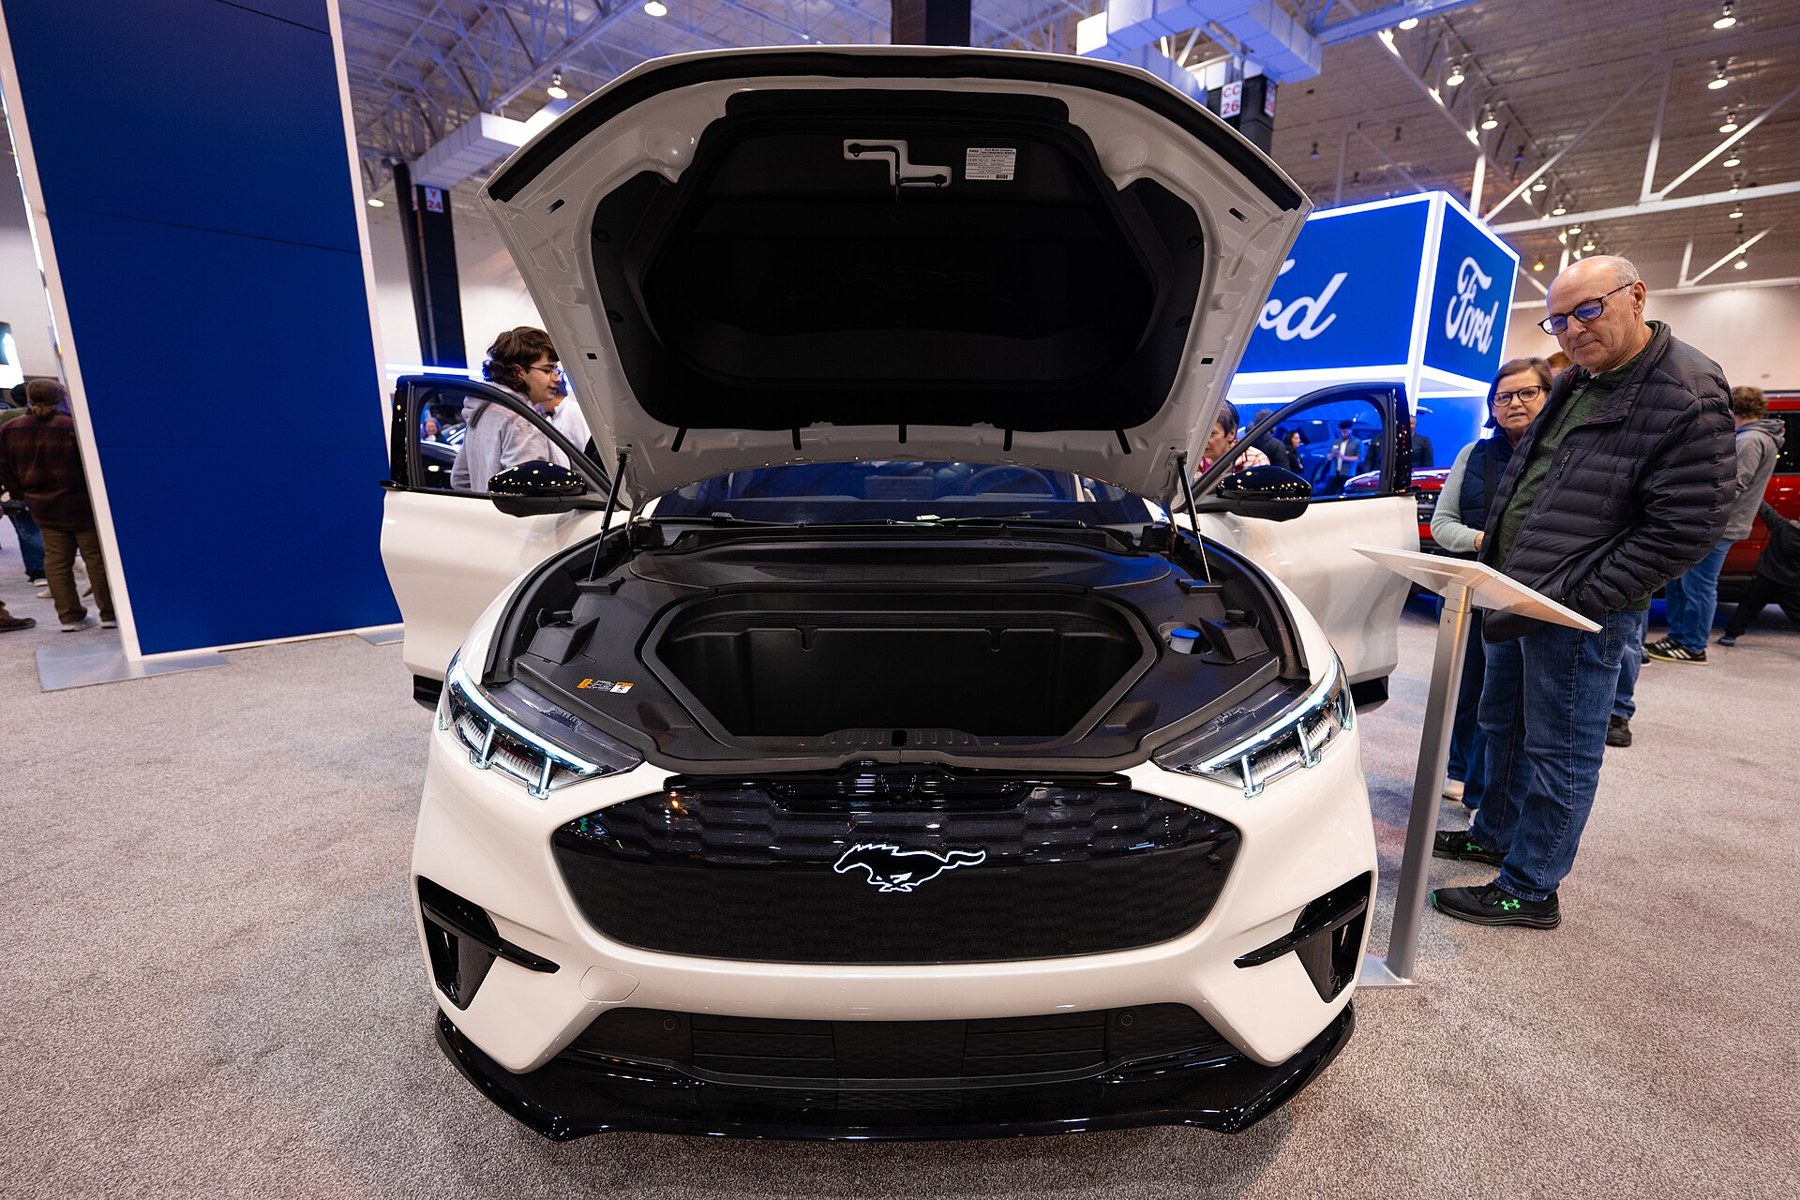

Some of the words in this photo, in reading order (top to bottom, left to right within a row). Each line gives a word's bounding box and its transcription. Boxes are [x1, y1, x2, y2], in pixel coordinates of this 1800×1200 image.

[1222, 100, 1239, 115] 26
[1223, 84, 1241, 98] CC
[1257, 258, 1348, 342] rd
[1445, 256, 1499, 354] Ford
